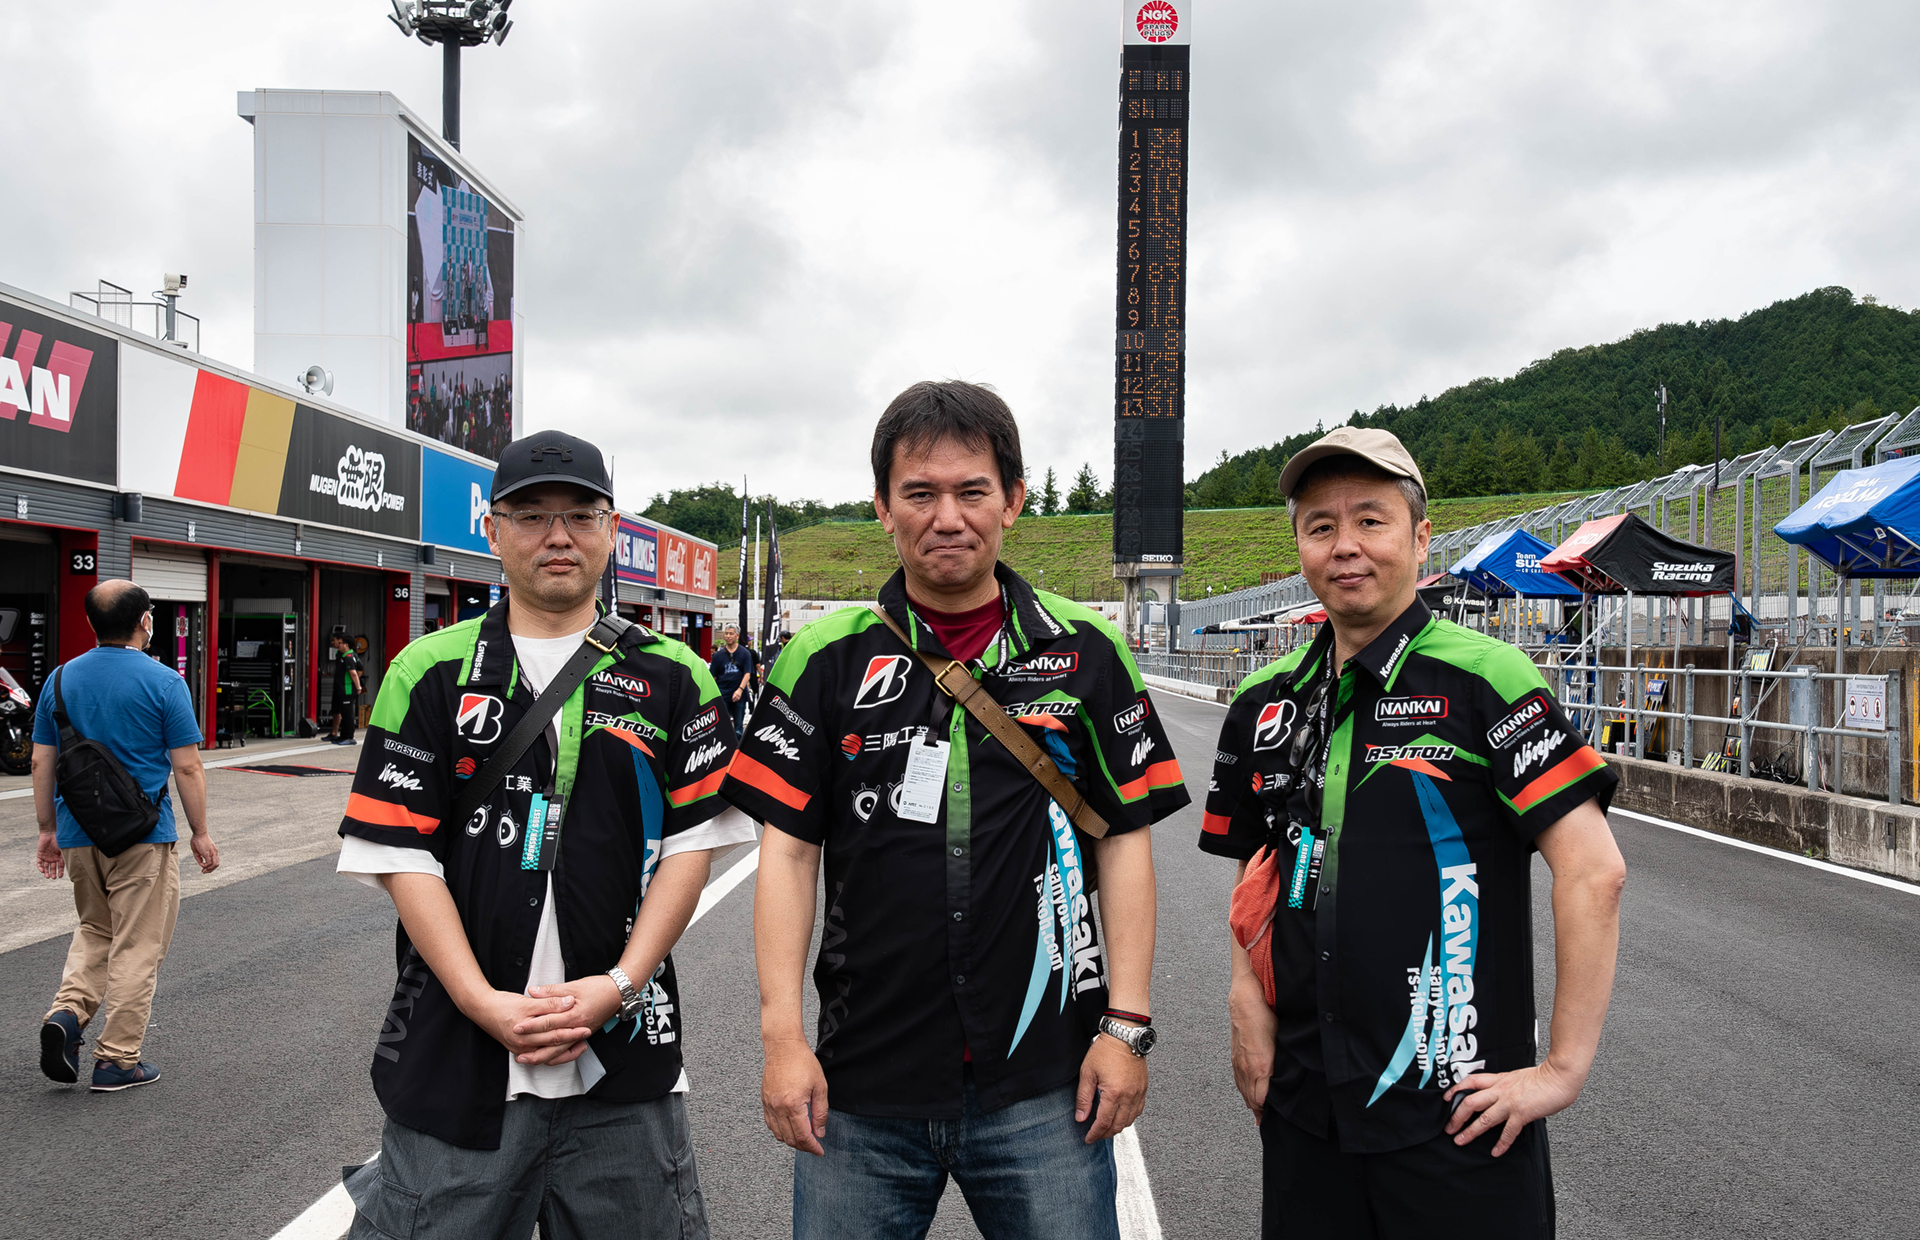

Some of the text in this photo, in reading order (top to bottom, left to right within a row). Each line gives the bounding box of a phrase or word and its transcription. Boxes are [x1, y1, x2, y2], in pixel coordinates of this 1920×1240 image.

[1142, 9, 1172, 21] NGK
[1132, 128, 1181, 148] 1 34
[1129, 153, 1141, 171] 2
[1129, 173, 1181, 193] 3 10
[1129, 197, 1141, 214] 4
[1128, 220, 1140, 238] 5
[1128, 242, 1140, 260] 6
[1128, 263, 1180, 283] 7 83
[1127, 285, 1177, 305] 8 11
[1128, 309, 1140, 327] 9
[1124, 331, 1144, 350] 10
[0, 356, 70, 422] AN
[1123, 376, 1144, 394] 12
[1123, 398, 1143, 416] 13
[309, 473, 339, 496] MUGEN
[381, 491, 405, 511] POWER
[17, 500, 27, 514] 33
[73, 555, 94, 570] 33
[1141, 554, 1174, 563] SEIKO
[1516, 552, 1536, 560] Team
[1651, 562, 1716, 572] Suzuka
[1652, 571, 1713, 583] Racing
[394, 587, 409, 598] 36
[471, 640, 488, 682] Kawasaki
[1380, 633, 1409, 678] Kawasaki
[1380, 700, 1441, 716] NANKAI
[1492, 702, 1542, 743] NANKAI
[754, 724, 800, 761] Ninja
[684, 737, 727, 774] Ninja
[1364, 745, 1456, 762] RS-ITOH
[1513, 729, 1567, 778] Ninja
[378, 762, 423, 790] Ninja
[526, 832, 538, 861] SPONSOR
[532, 808, 542, 828] GUEST
[1293, 868, 1305, 899] SPONSOR
[1299, 843, 1310, 864] GUEST
[1033, 873, 1065, 971] rs-itoh.com
[1406, 967, 1431, 1070] rs-itoh.com
